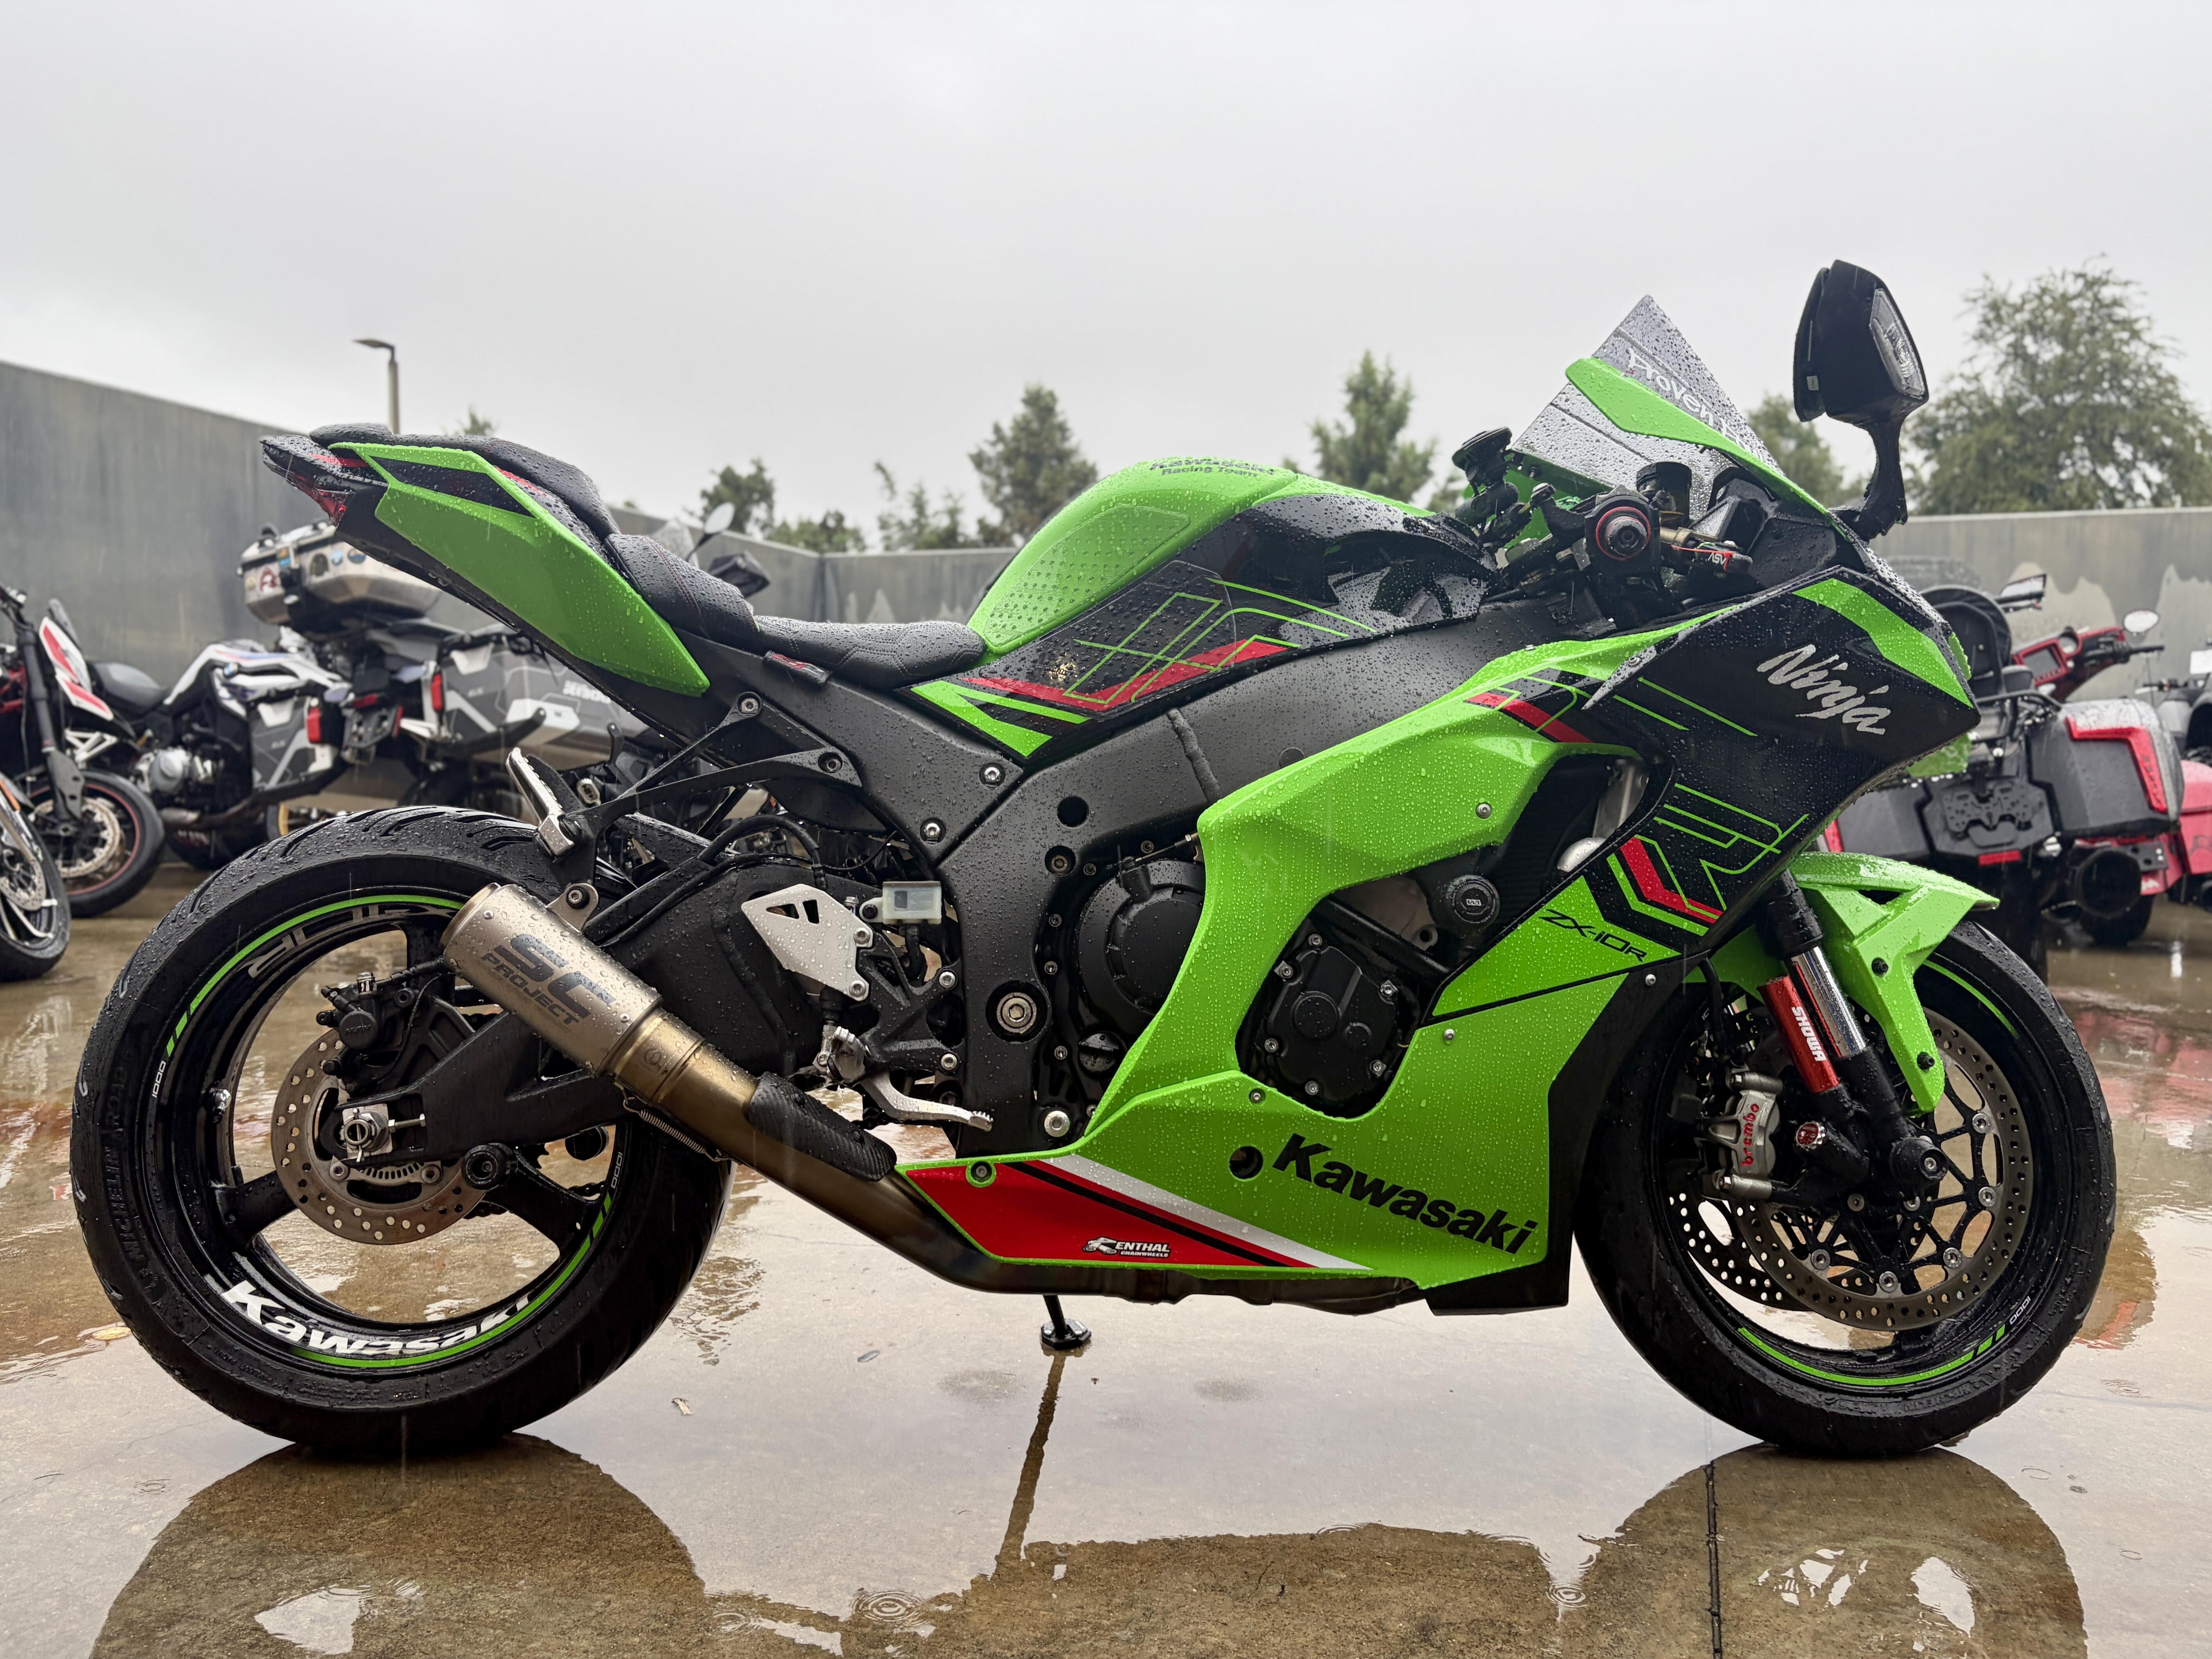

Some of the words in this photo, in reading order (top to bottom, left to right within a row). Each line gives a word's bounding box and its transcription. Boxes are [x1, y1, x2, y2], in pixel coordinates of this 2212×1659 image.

[1161, 466, 1212, 476] Racing
[1217, 466, 1257, 477] Team
[1756, 644, 1891, 734] Ninja
[1538, 909, 1647, 962] ZX-10R
[481, 953, 579, 1027] PROJECT
[493, 934, 616, 1018] SC
[1791, 1006, 1826, 1061] SHOWA
[152, 1060, 166, 1098] 1000
[1740, 1104, 1760, 1166] brembo
[611, 1152, 623, 1189] 1000
[1272, 1133, 1538, 1255] Kawasaki
[2009, 1296, 2031, 1325] 1000
